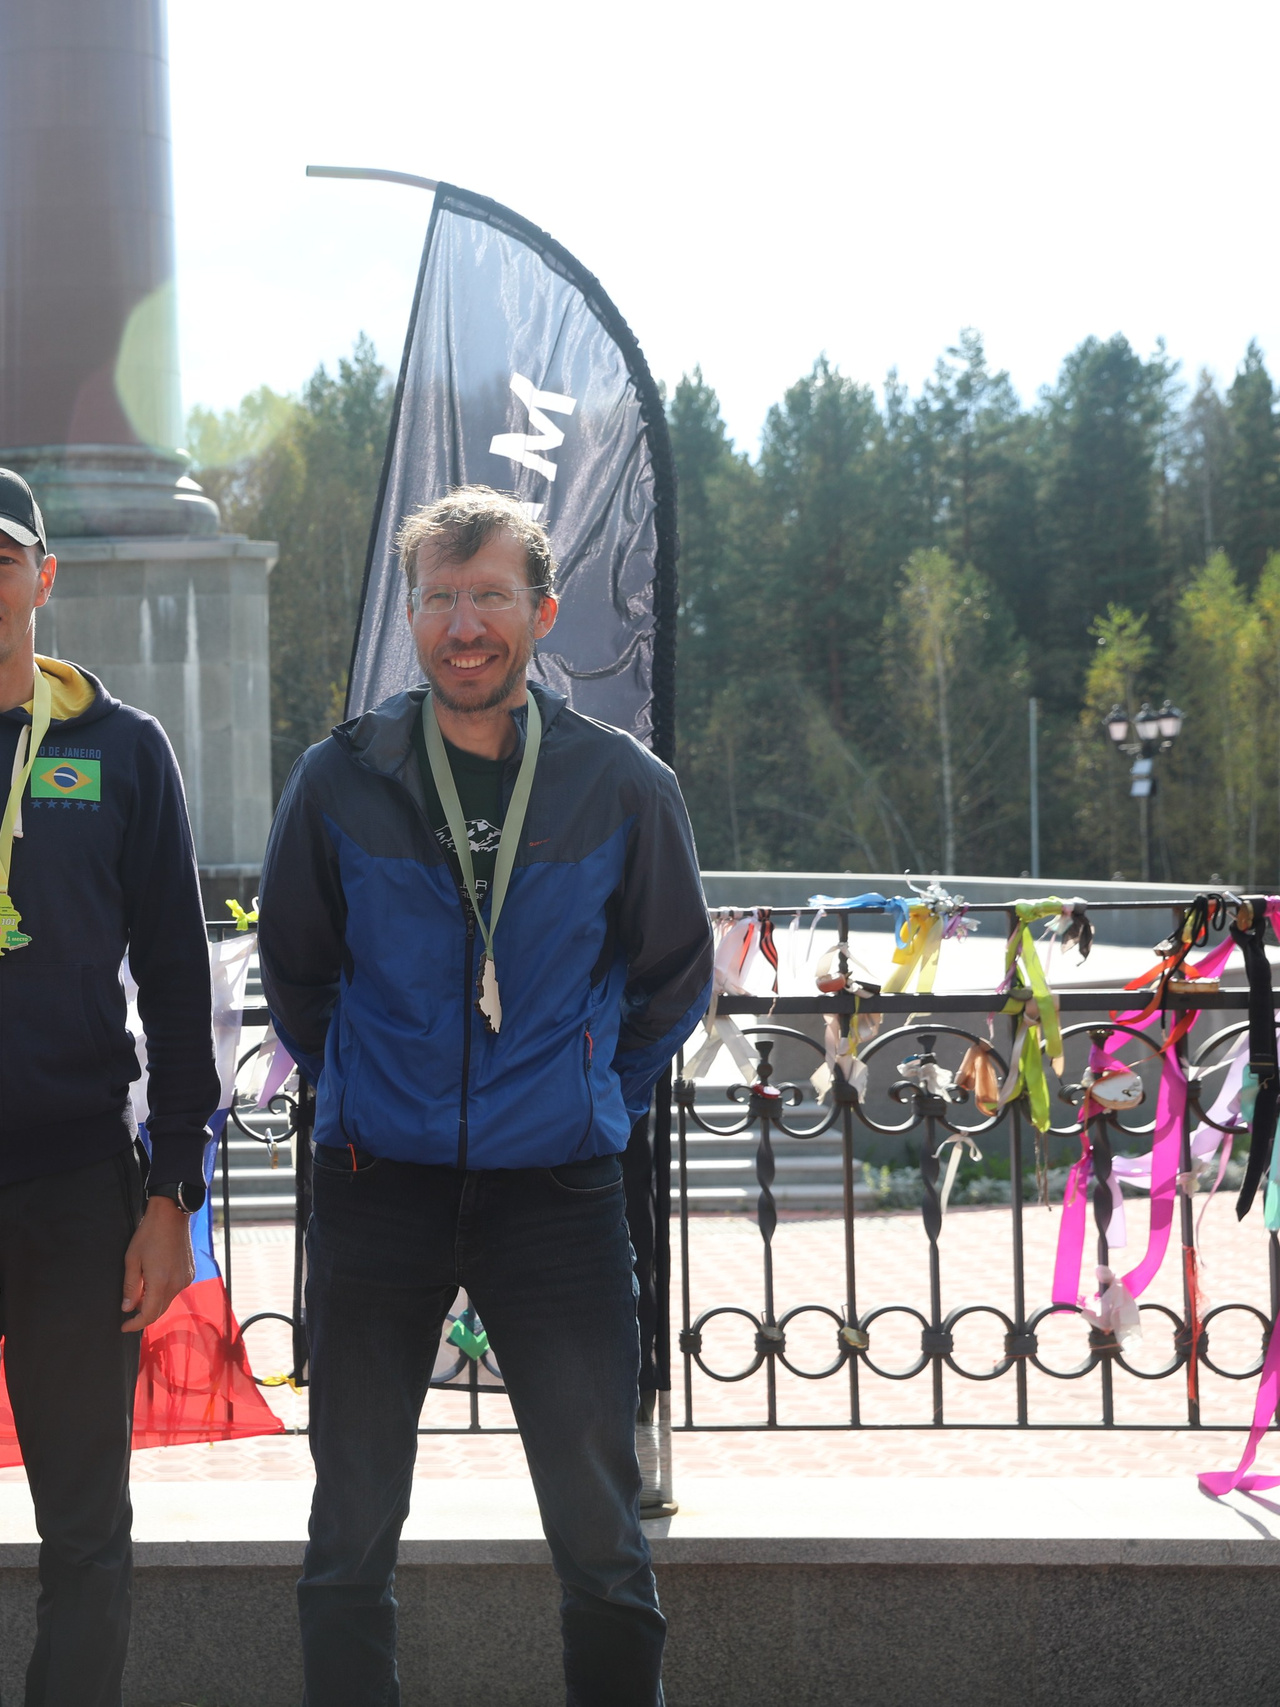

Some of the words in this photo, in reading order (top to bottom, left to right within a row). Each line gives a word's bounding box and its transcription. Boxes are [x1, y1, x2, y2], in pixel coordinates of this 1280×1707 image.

[48, 746, 60, 757] DE
[62, 747, 102, 759] JANEIRO
[1, 918, 16, 926] 101
